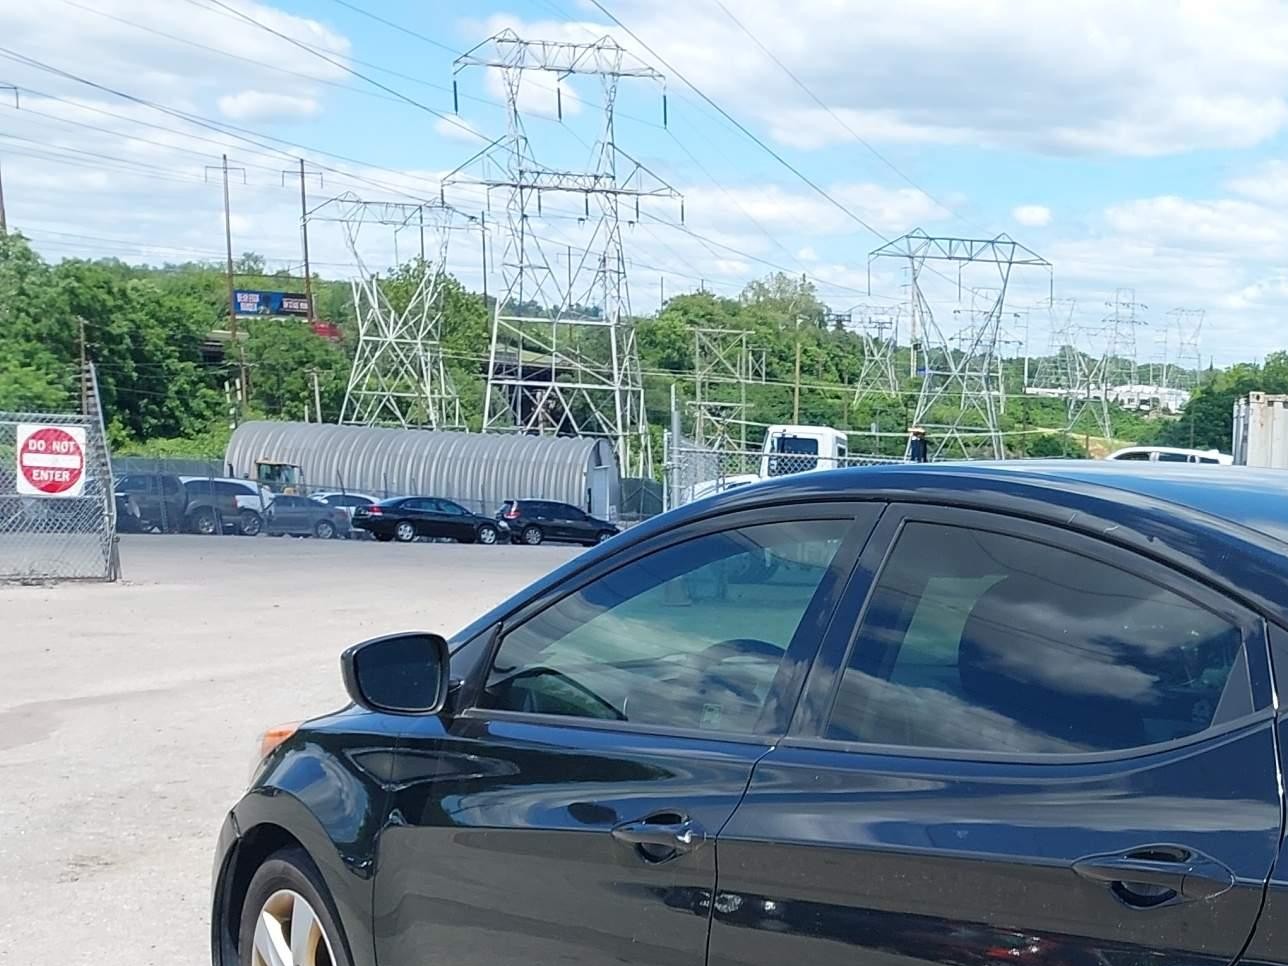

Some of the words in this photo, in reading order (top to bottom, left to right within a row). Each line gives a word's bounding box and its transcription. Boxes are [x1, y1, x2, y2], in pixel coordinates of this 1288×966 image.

[28, 439, 46, 450] DO
[52, 441, 75, 453] NOT
[32, 469, 70, 482] ENTER
